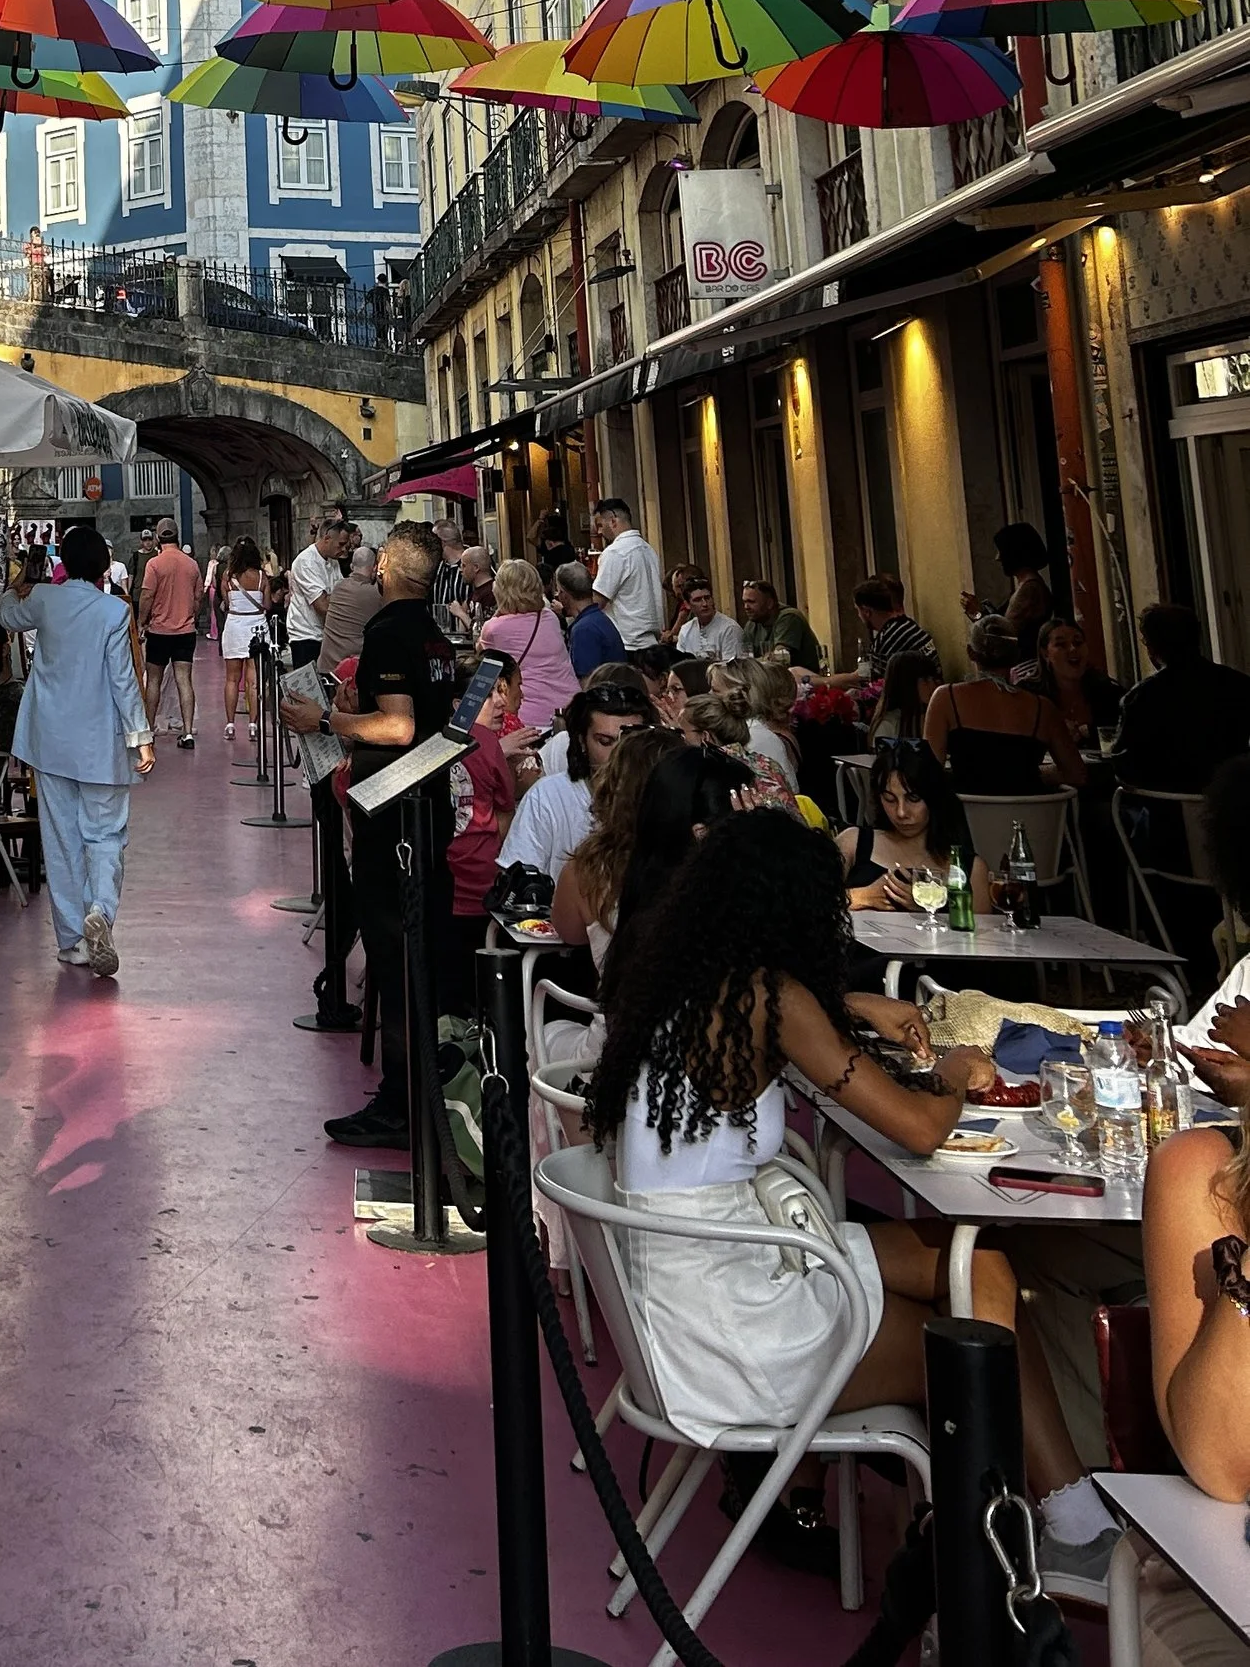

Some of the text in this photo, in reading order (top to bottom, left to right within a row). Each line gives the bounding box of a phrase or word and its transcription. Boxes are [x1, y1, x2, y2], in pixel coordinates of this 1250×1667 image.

[693, 240, 768, 283] BC
[705, 285, 724, 293] BAR
[725, 284, 740, 293] DO
[86, 484, 103, 492] ATM
